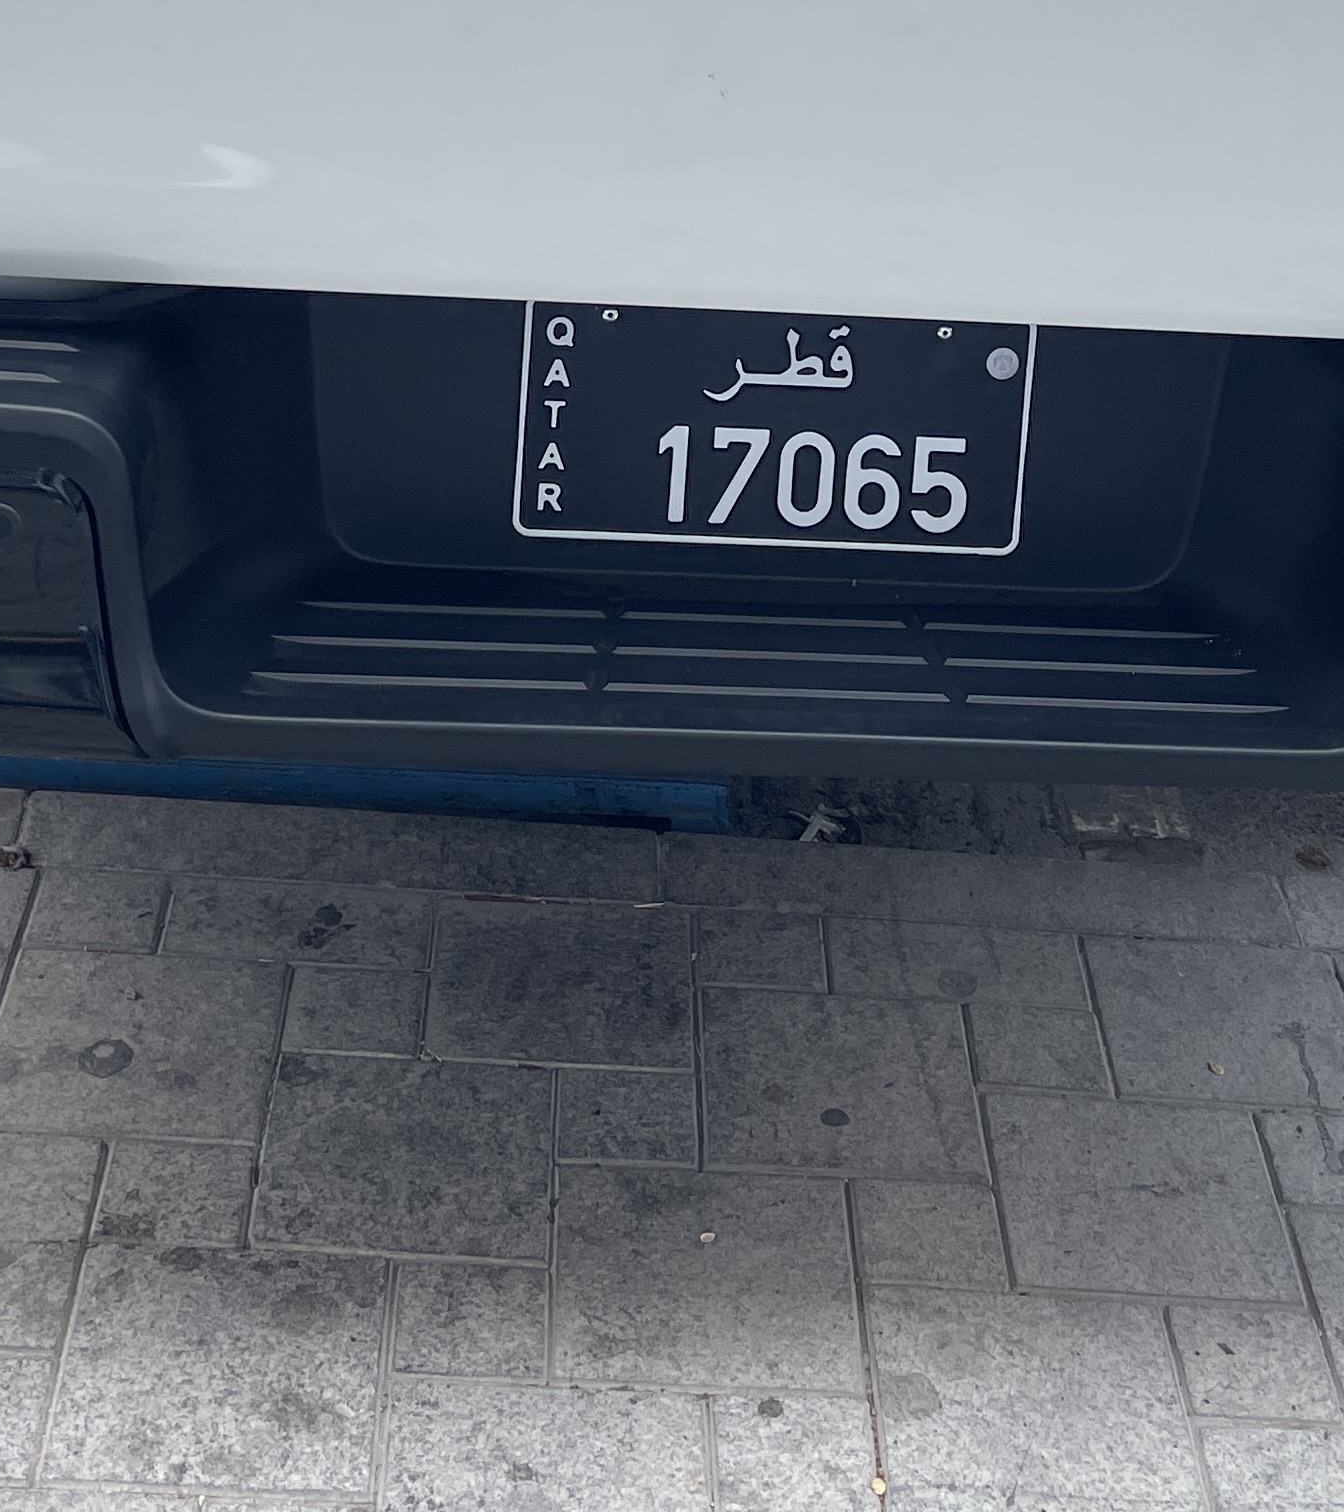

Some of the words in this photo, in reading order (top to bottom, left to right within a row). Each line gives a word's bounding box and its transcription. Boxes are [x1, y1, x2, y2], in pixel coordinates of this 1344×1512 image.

[536, 316, 576, 513] QATAR
[703, 324, 854, 402] قطر
[658, 424, 968, 534] 17065
